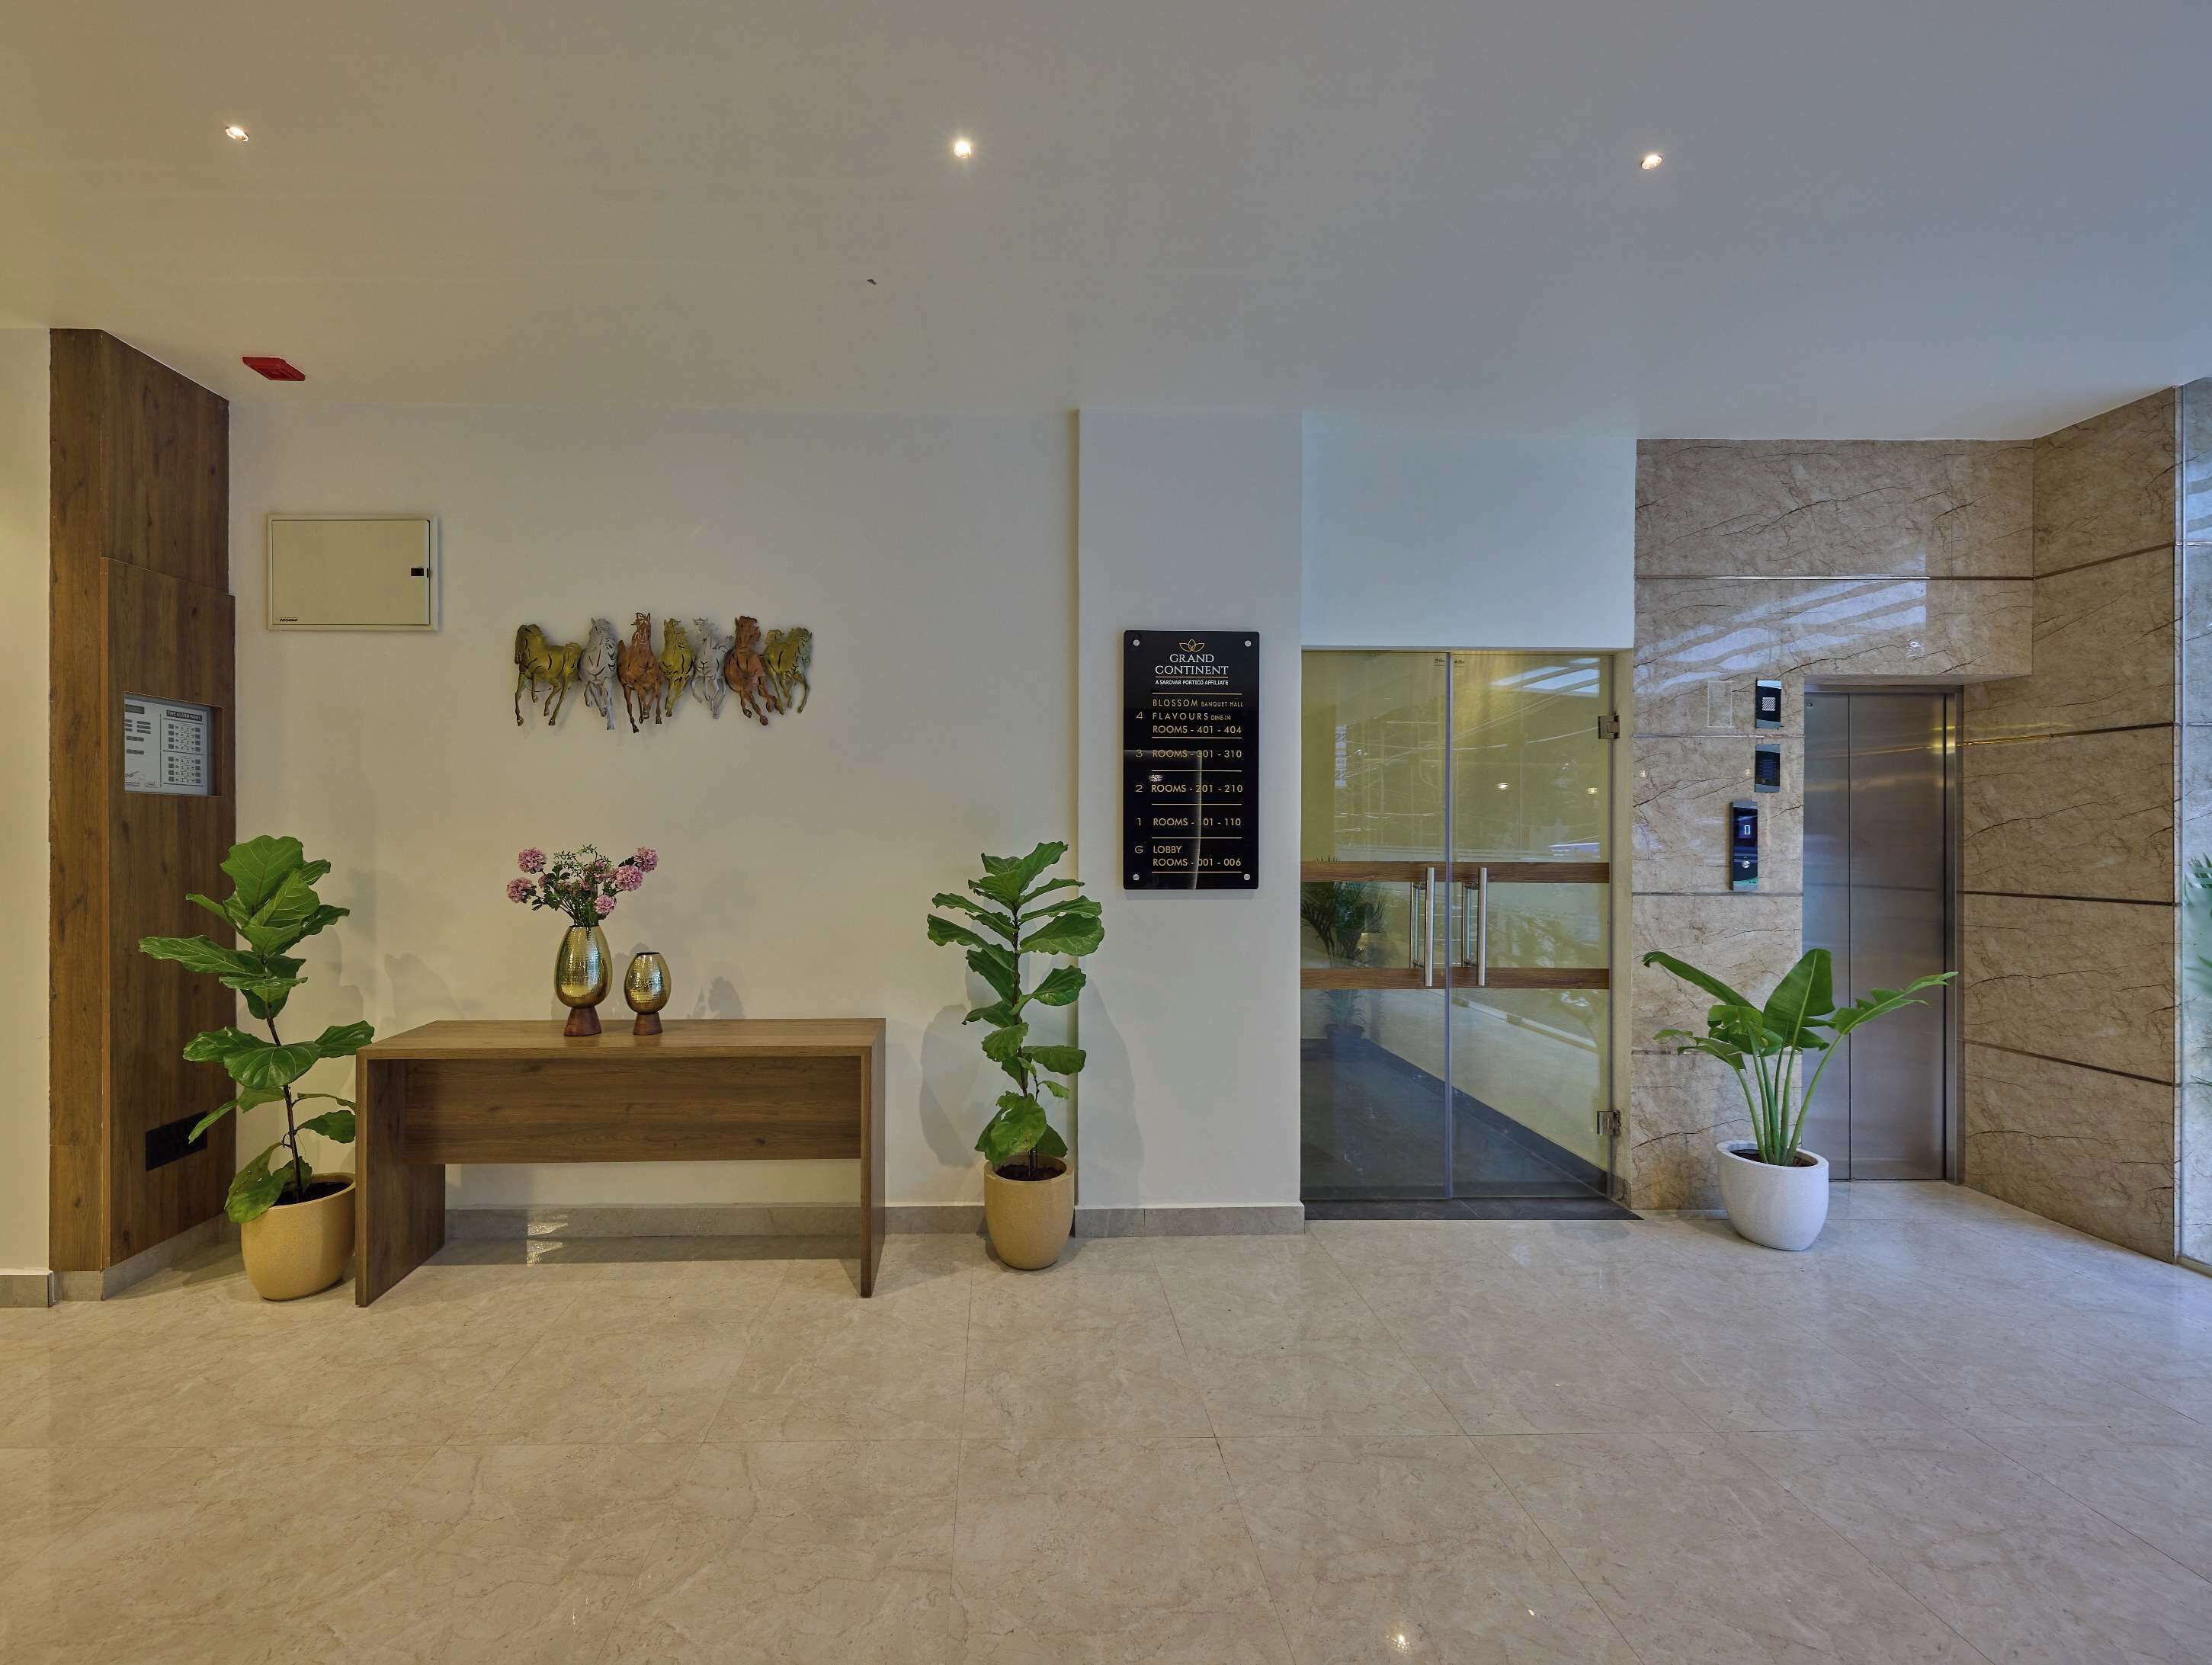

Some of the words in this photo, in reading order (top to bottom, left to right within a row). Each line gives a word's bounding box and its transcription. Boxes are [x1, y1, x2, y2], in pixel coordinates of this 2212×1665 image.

[1169, 653, 1214, 663] GRAND
[1155, 665, 1229, 674] CONTINENT
[1152, 699, 1198, 707] BLOSSOM
[1152, 725, 1188, 734] ROOMS
[1197, 725, 1213, 734] 401
[1224, 725, 1242, 734] 404
[1135, 749, 1143, 757] 3
[1152, 749, 1188, 757] ROOMS
[1197, 750, 1213, 758] 301
[1224, 750, 1242, 758] 310
[1135, 784, 1143, 792] 2
[1151, 784, 1187, 792] ROOMS
[1195, 784, 1213, 792] 201
[1224, 784, 1243, 792] 210
[1136, 818, 1141, 826] 1
[1153, 818, 1188, 826] ROOMS
[1197, 818, 1213, 826] 01
[1225, 818, 1242, 826] 110
[1134, 845, 1143, 853] G
[1152, 845, 1182, 853] LOBBY
[1152, 858, 1188, 866] ROOMS
[1197, 858, 1213, 866] 001
[1223, 858, 1242, 866] 006
